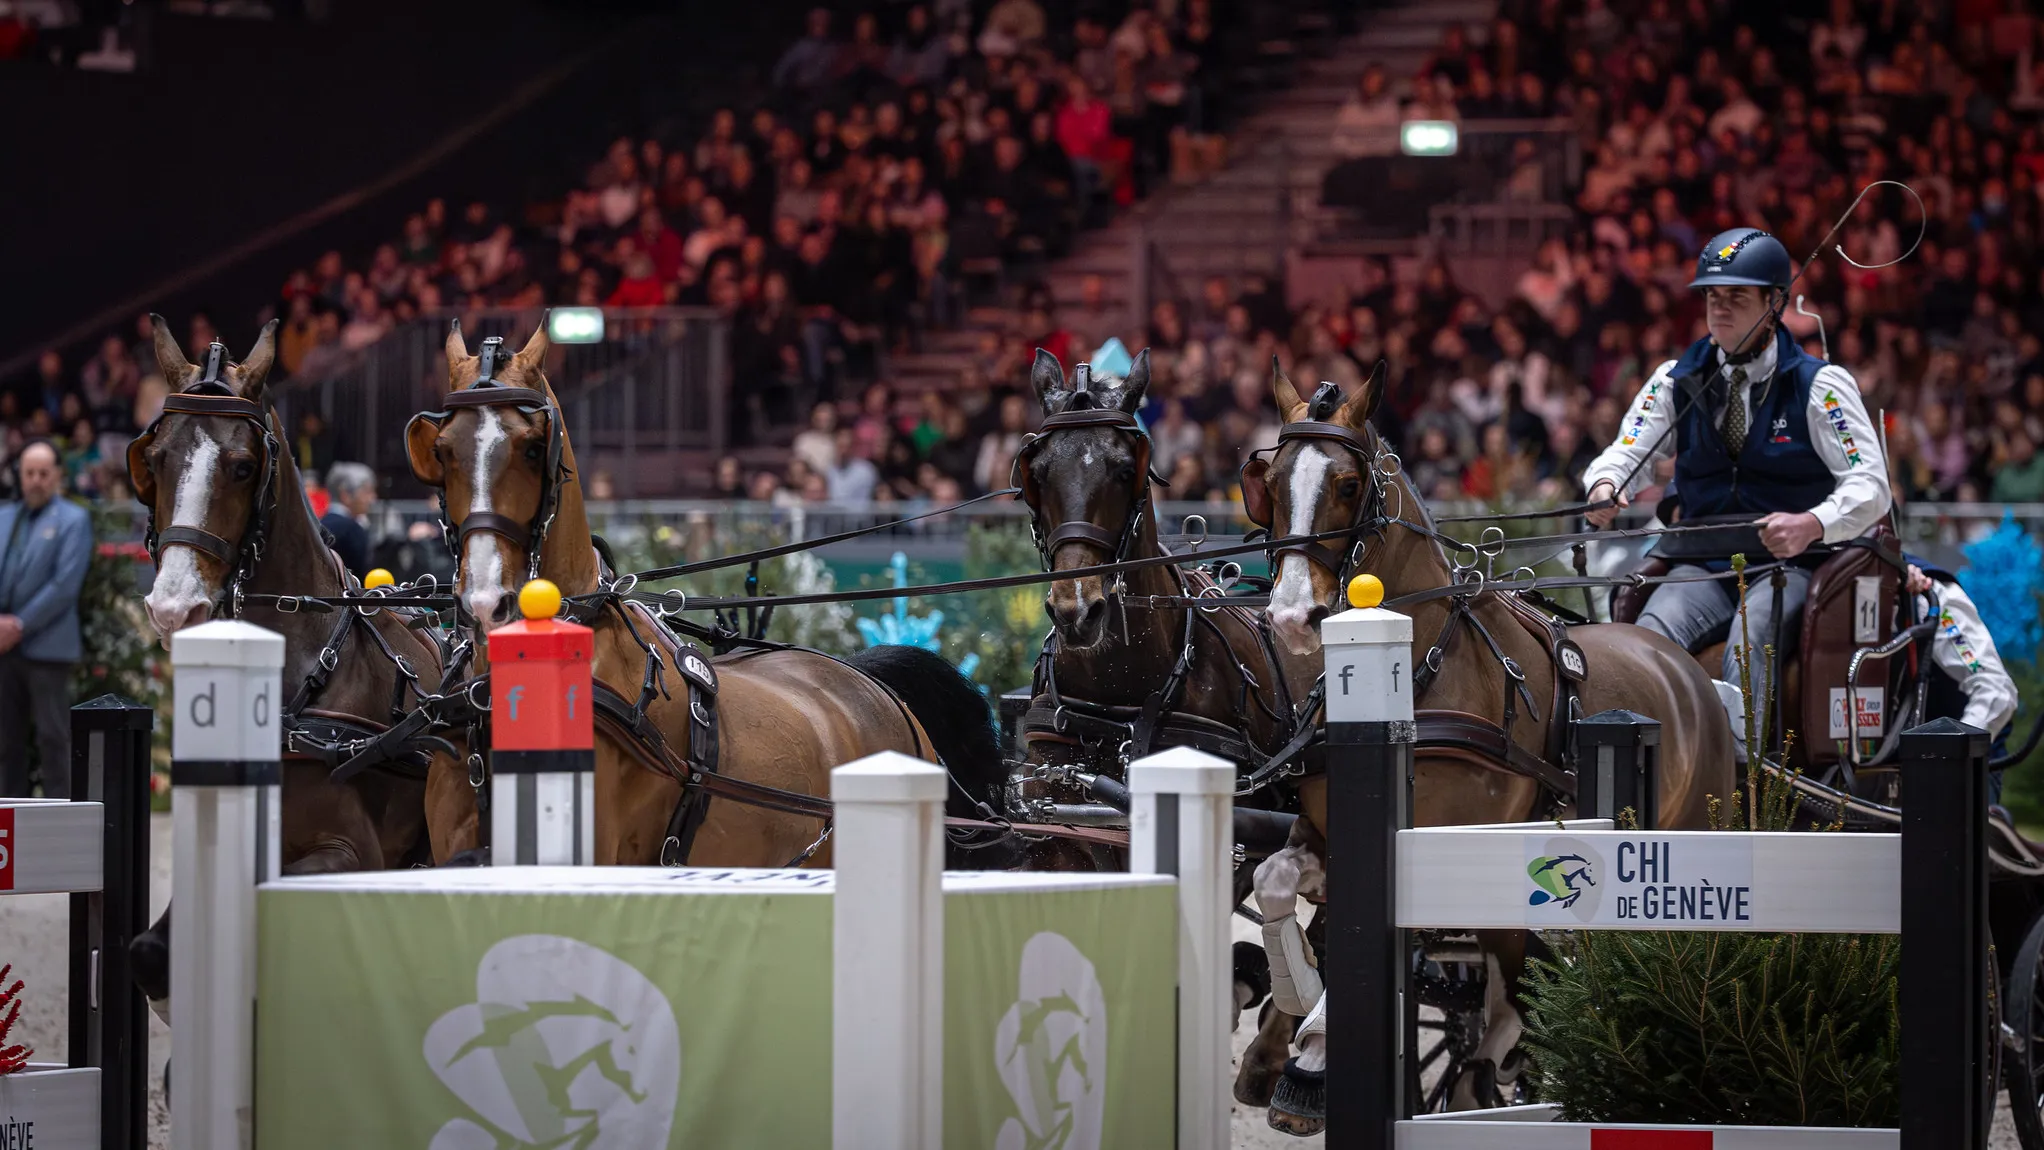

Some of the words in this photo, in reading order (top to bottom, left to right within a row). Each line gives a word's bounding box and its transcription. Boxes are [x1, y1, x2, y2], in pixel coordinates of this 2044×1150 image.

[1824, 390, 1863, 468] VERNAFIX
[1861, 600, 1876, 630] 11
[1338, 664, 1355, 695] f
[1391, 662, 1400, 693] f
[190, 681, 216, 728] d
[253, 681, 270, 728] d
[505, 684, 526, 721] f
[565, 684, 579, 721] f
[1616, 841, 1670, 883] CHI
[1616, 896, 1638, 919] DE
[1643, 878, 1750, 920] GENÈVE
